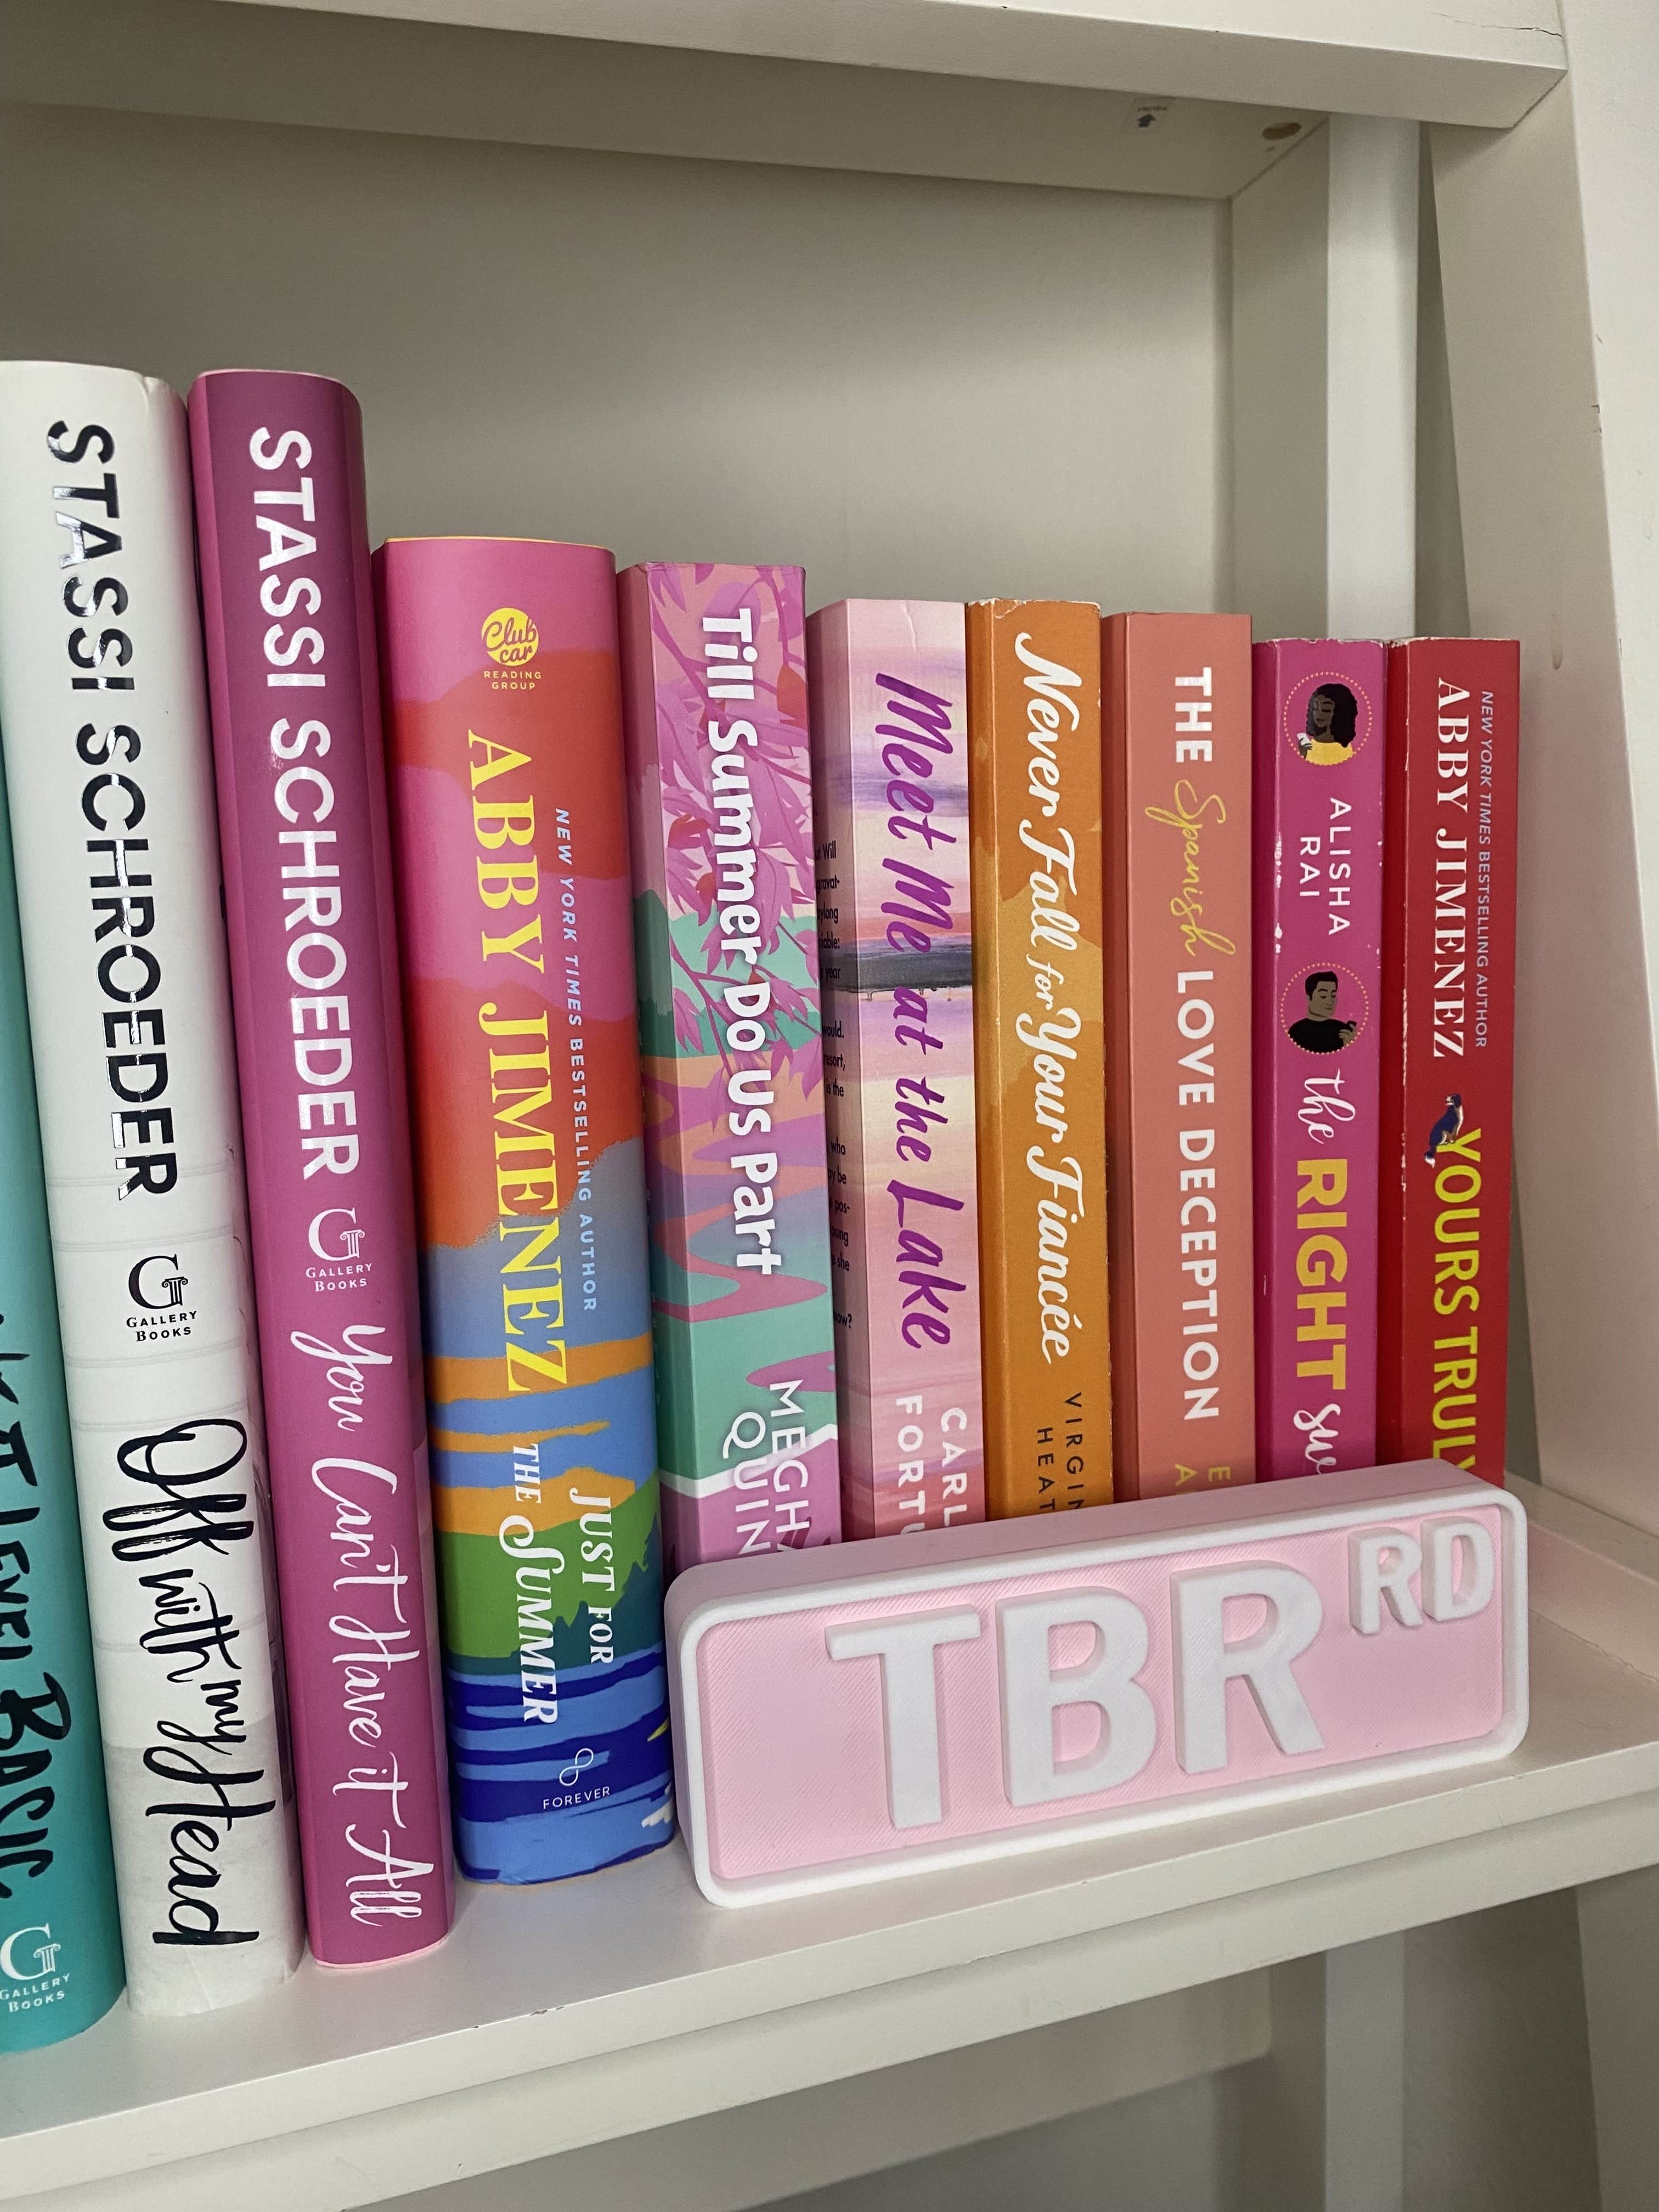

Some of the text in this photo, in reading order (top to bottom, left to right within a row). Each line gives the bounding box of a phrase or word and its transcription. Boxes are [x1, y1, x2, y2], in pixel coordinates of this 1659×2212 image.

[483, 616, 538, 645] Club
[483, 670, 542, 680] READING
[492, 681, 536, 690] GROUP
[499, 642, 533, 665] car
[702, 608, 758, 701] Till
[1175, 667, 1212, 763] THE
[47, 420, 177, 1201] STASSI SCHROEDER
[250, 427, 359, 1181] STASSI SCHROEDER
[708, 720, 761, 965] Summer
[1145, 779, 1236, 957] Spanish
[1299, 836, 1321, 898] RAI
[1328, 797, 1352, 936] ALISHA
[1432, 676, 1471, 1058] ABBY JIMENEZ
[1475, 690, 1493, 1048] NEW YORK TIMES BESTSELLING AUTHOR
[467, 729, 568, 1392] ABBY JIMENEZ
[555, 808, 597, 1312] NEW YORK TIMES BESTSELLING AUTHOR
[724, 981, 771, 1052] Do
[876, 673, 967, 1350] Meet Me at the Lake
[1015, 632, 1085, 1364] Never Fall for Your Fiancée
[1177, 970, 1215, 1106] LOVE
[1297, 1068, 1356, 1144] the
[305, 1262, 373, 1279] GALLERY
[314, 1278, 367, 1292] BOOKS
[1179, 1128, 1220, 1420] DECEPTION
[1295, 1158, 1348, 1390] RIGHT
[1433, 1127, 1482, 1316] YOURS
[126, 1311, 198, 1328] GALLERY
[136, 1327, 192, 1342] BOOKS
[770, 1379, 810, 1553] MEGH
[290, 1324, 435, 1927] You Can't Have it All
[498, 1443, 566, 1725] THE SUMMER
[569, 1487, 616, 1665] JUST FOR
[102, 1418, 276, 1945] Off with my Head
[825, 1516, 1494, 1830] TBR RD
[543, 1786, 611, 1810] FOREVER
